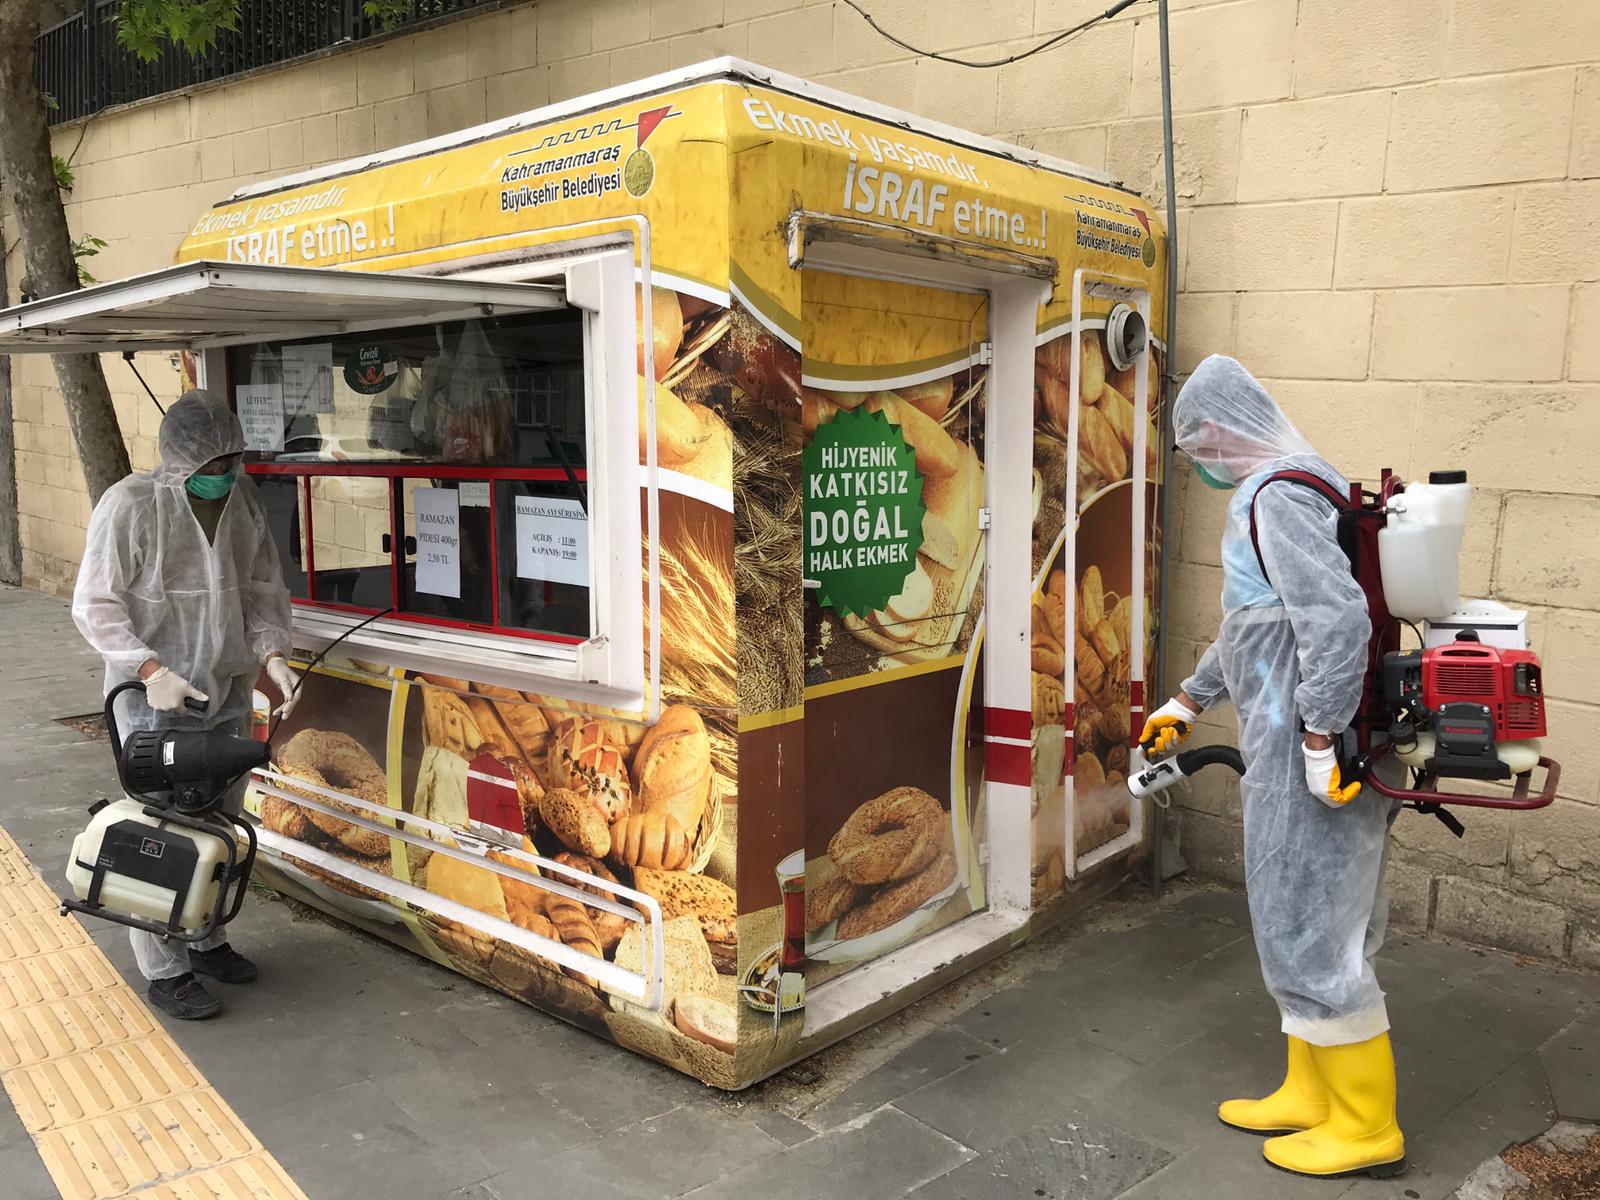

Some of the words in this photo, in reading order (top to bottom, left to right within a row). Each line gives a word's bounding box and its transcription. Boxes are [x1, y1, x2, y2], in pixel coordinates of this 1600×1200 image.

[743, 98, 861, 151] Ekmek
[860, 132, 990, 189] yaşamdır,
[501, 144, 621, 183] Kahramanmaraş
[501, 181, 560, 212] Büyükşehir
[562, 168, 621, 200] Belediyesi
[843, 153, 949, 227] İSRAF
[953, 198, 1047, 250] etme..!
[191, 203, 255, 236] Ekmek
[248, 185, 349, 230] yaşamdır,
[1074, 208, 1142, 240] Kahramanmaraş
[226, 225, 297, 264] İSRAF
[301, 202, 396, 260] etme..!
[1076, 229, 1110, 251] Büyükşehir
[1110, 238, 1141, 259] Belediyesi
[821, 441, 898, 469] HİJYENİK
[810, 470, 909, 499] KATKISIZ
[420, 513, 455, 525] RAMAZAN
[516, 505, 545, 515] RAMAZAN
[810, 500, 909, 547] DOĞAL
[419, 532, 440, 544] PİDESİ
[532, 533, 553, 544] AÇILIŞ
[441, 554, 450, 565] TL
[810, 549, 854, 573] HALK
[856, 542, 909, 567] EKMEK
